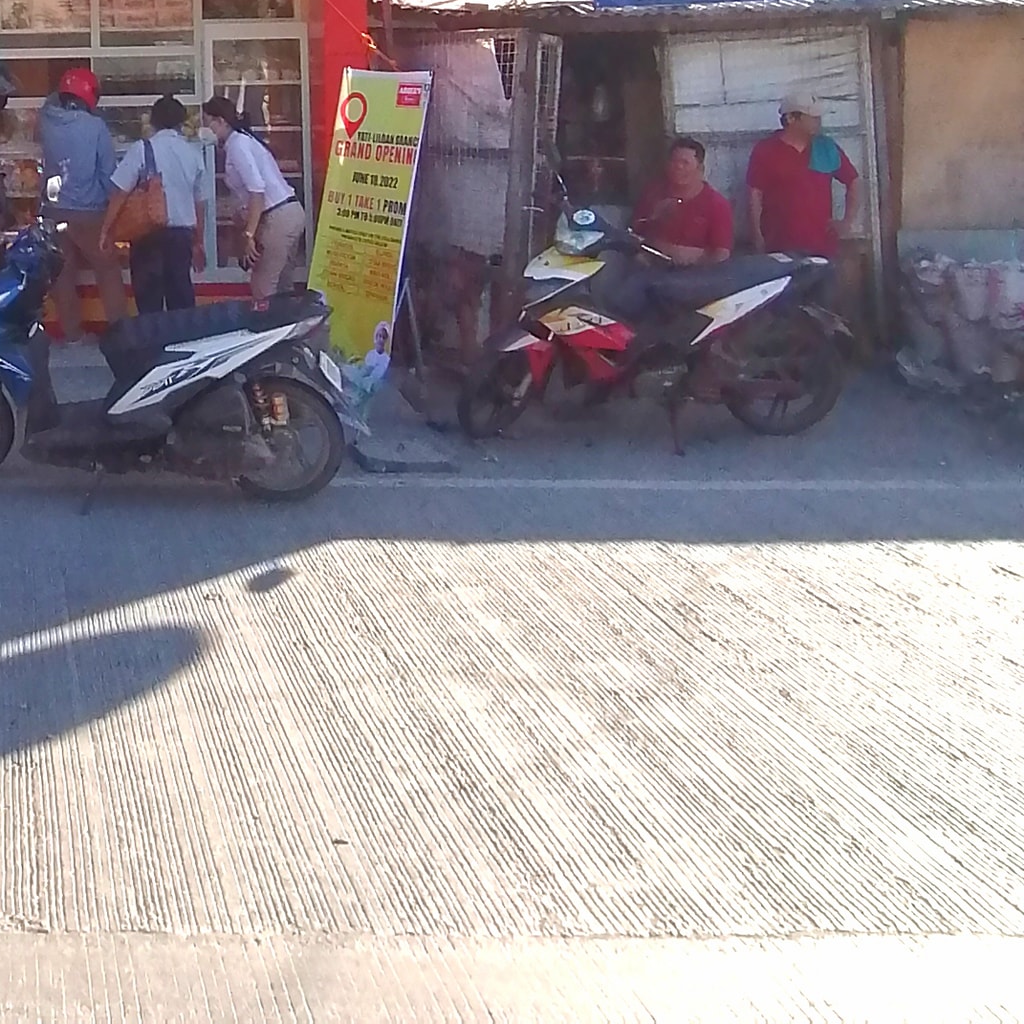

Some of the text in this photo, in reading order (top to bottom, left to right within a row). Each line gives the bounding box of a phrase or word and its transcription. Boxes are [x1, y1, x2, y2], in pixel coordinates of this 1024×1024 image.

[334, 139, 372, 160] GRAND
[351, 171, 370, 185] JUNE
[379, 175, 399, 189] 2022
[327, 190, 346, 205] BUY
[354, 194, 375, 211] TAKE
